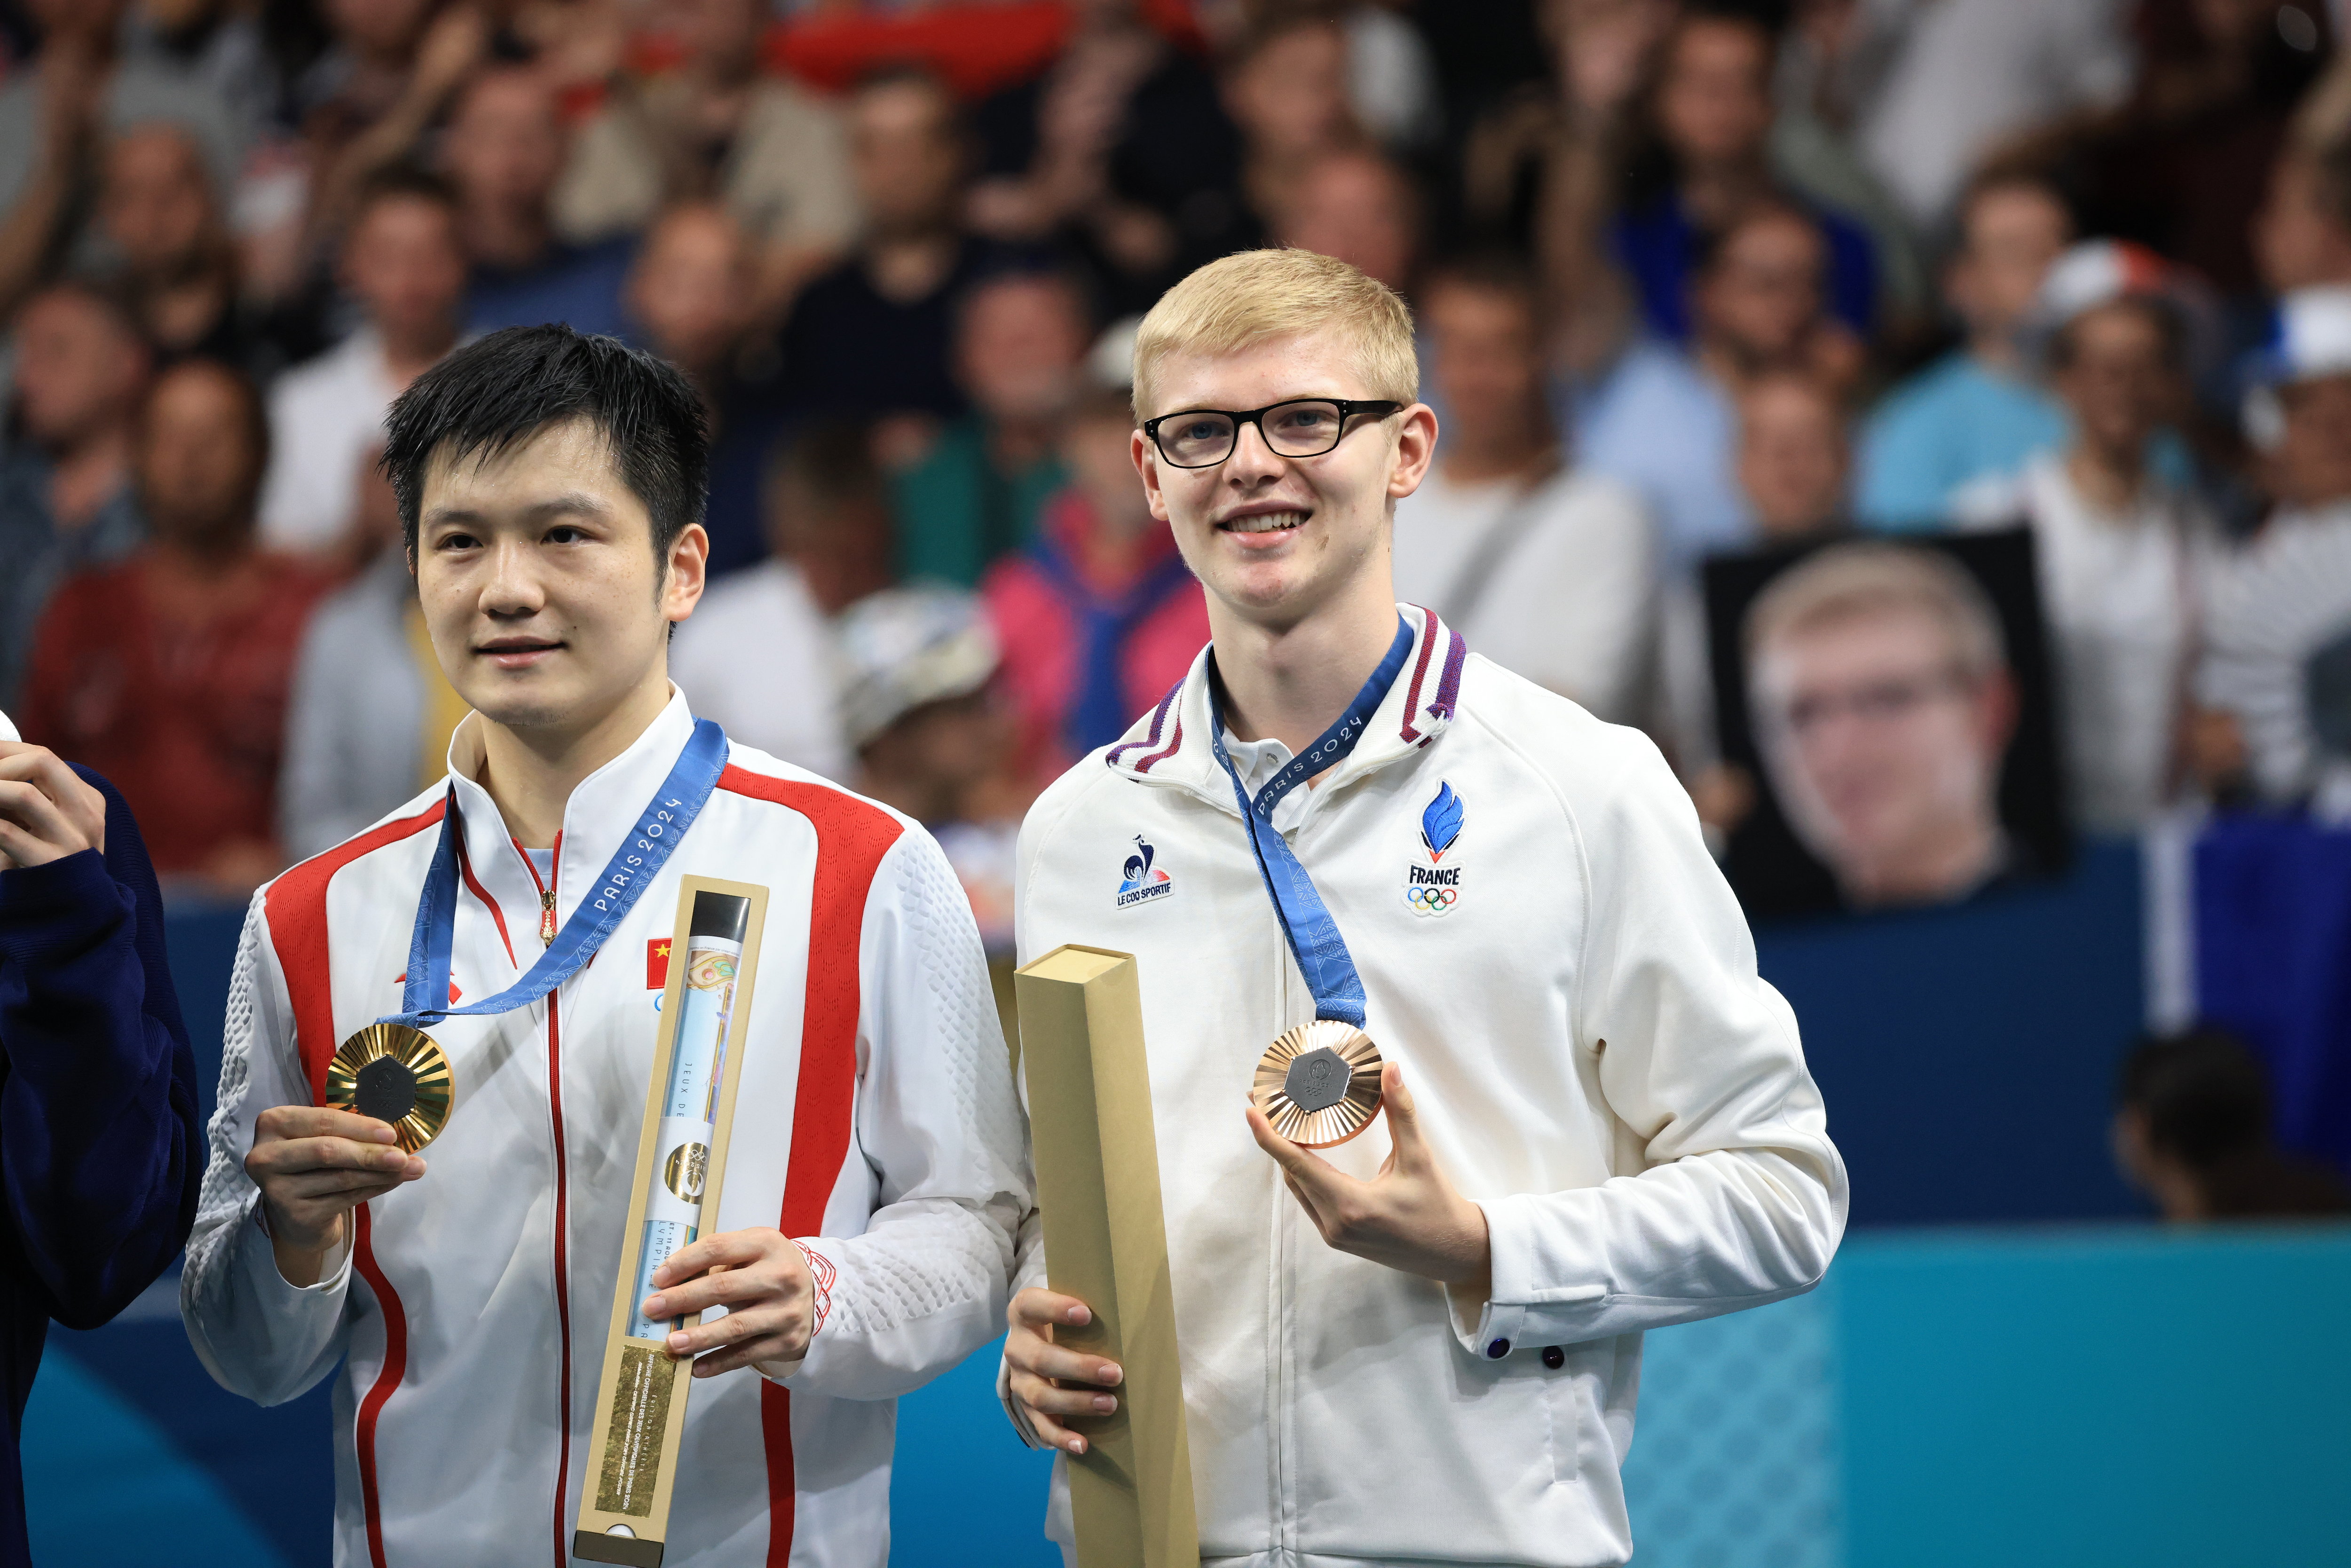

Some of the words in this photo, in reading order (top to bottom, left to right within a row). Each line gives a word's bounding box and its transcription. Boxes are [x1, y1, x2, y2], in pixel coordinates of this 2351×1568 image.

[1310, 716, 1362, 764] 2024
[638, 798, 682, 852] 2024
[1410, 865, 1460, 885] FRANCE
[1117, 895, 1125, 906] LE
[1141, 882, 1171, 898] SPORTIF
[681, 1063, 692, 1093] JEUX
[677, 1103, 686, 1117] DE
[645, 1354, 654, 1377] AFFICHE
[640, 1377, 650, 1408] OFFICIELLE
[630, 1433, 640, 1469] OLYMPIQUES
